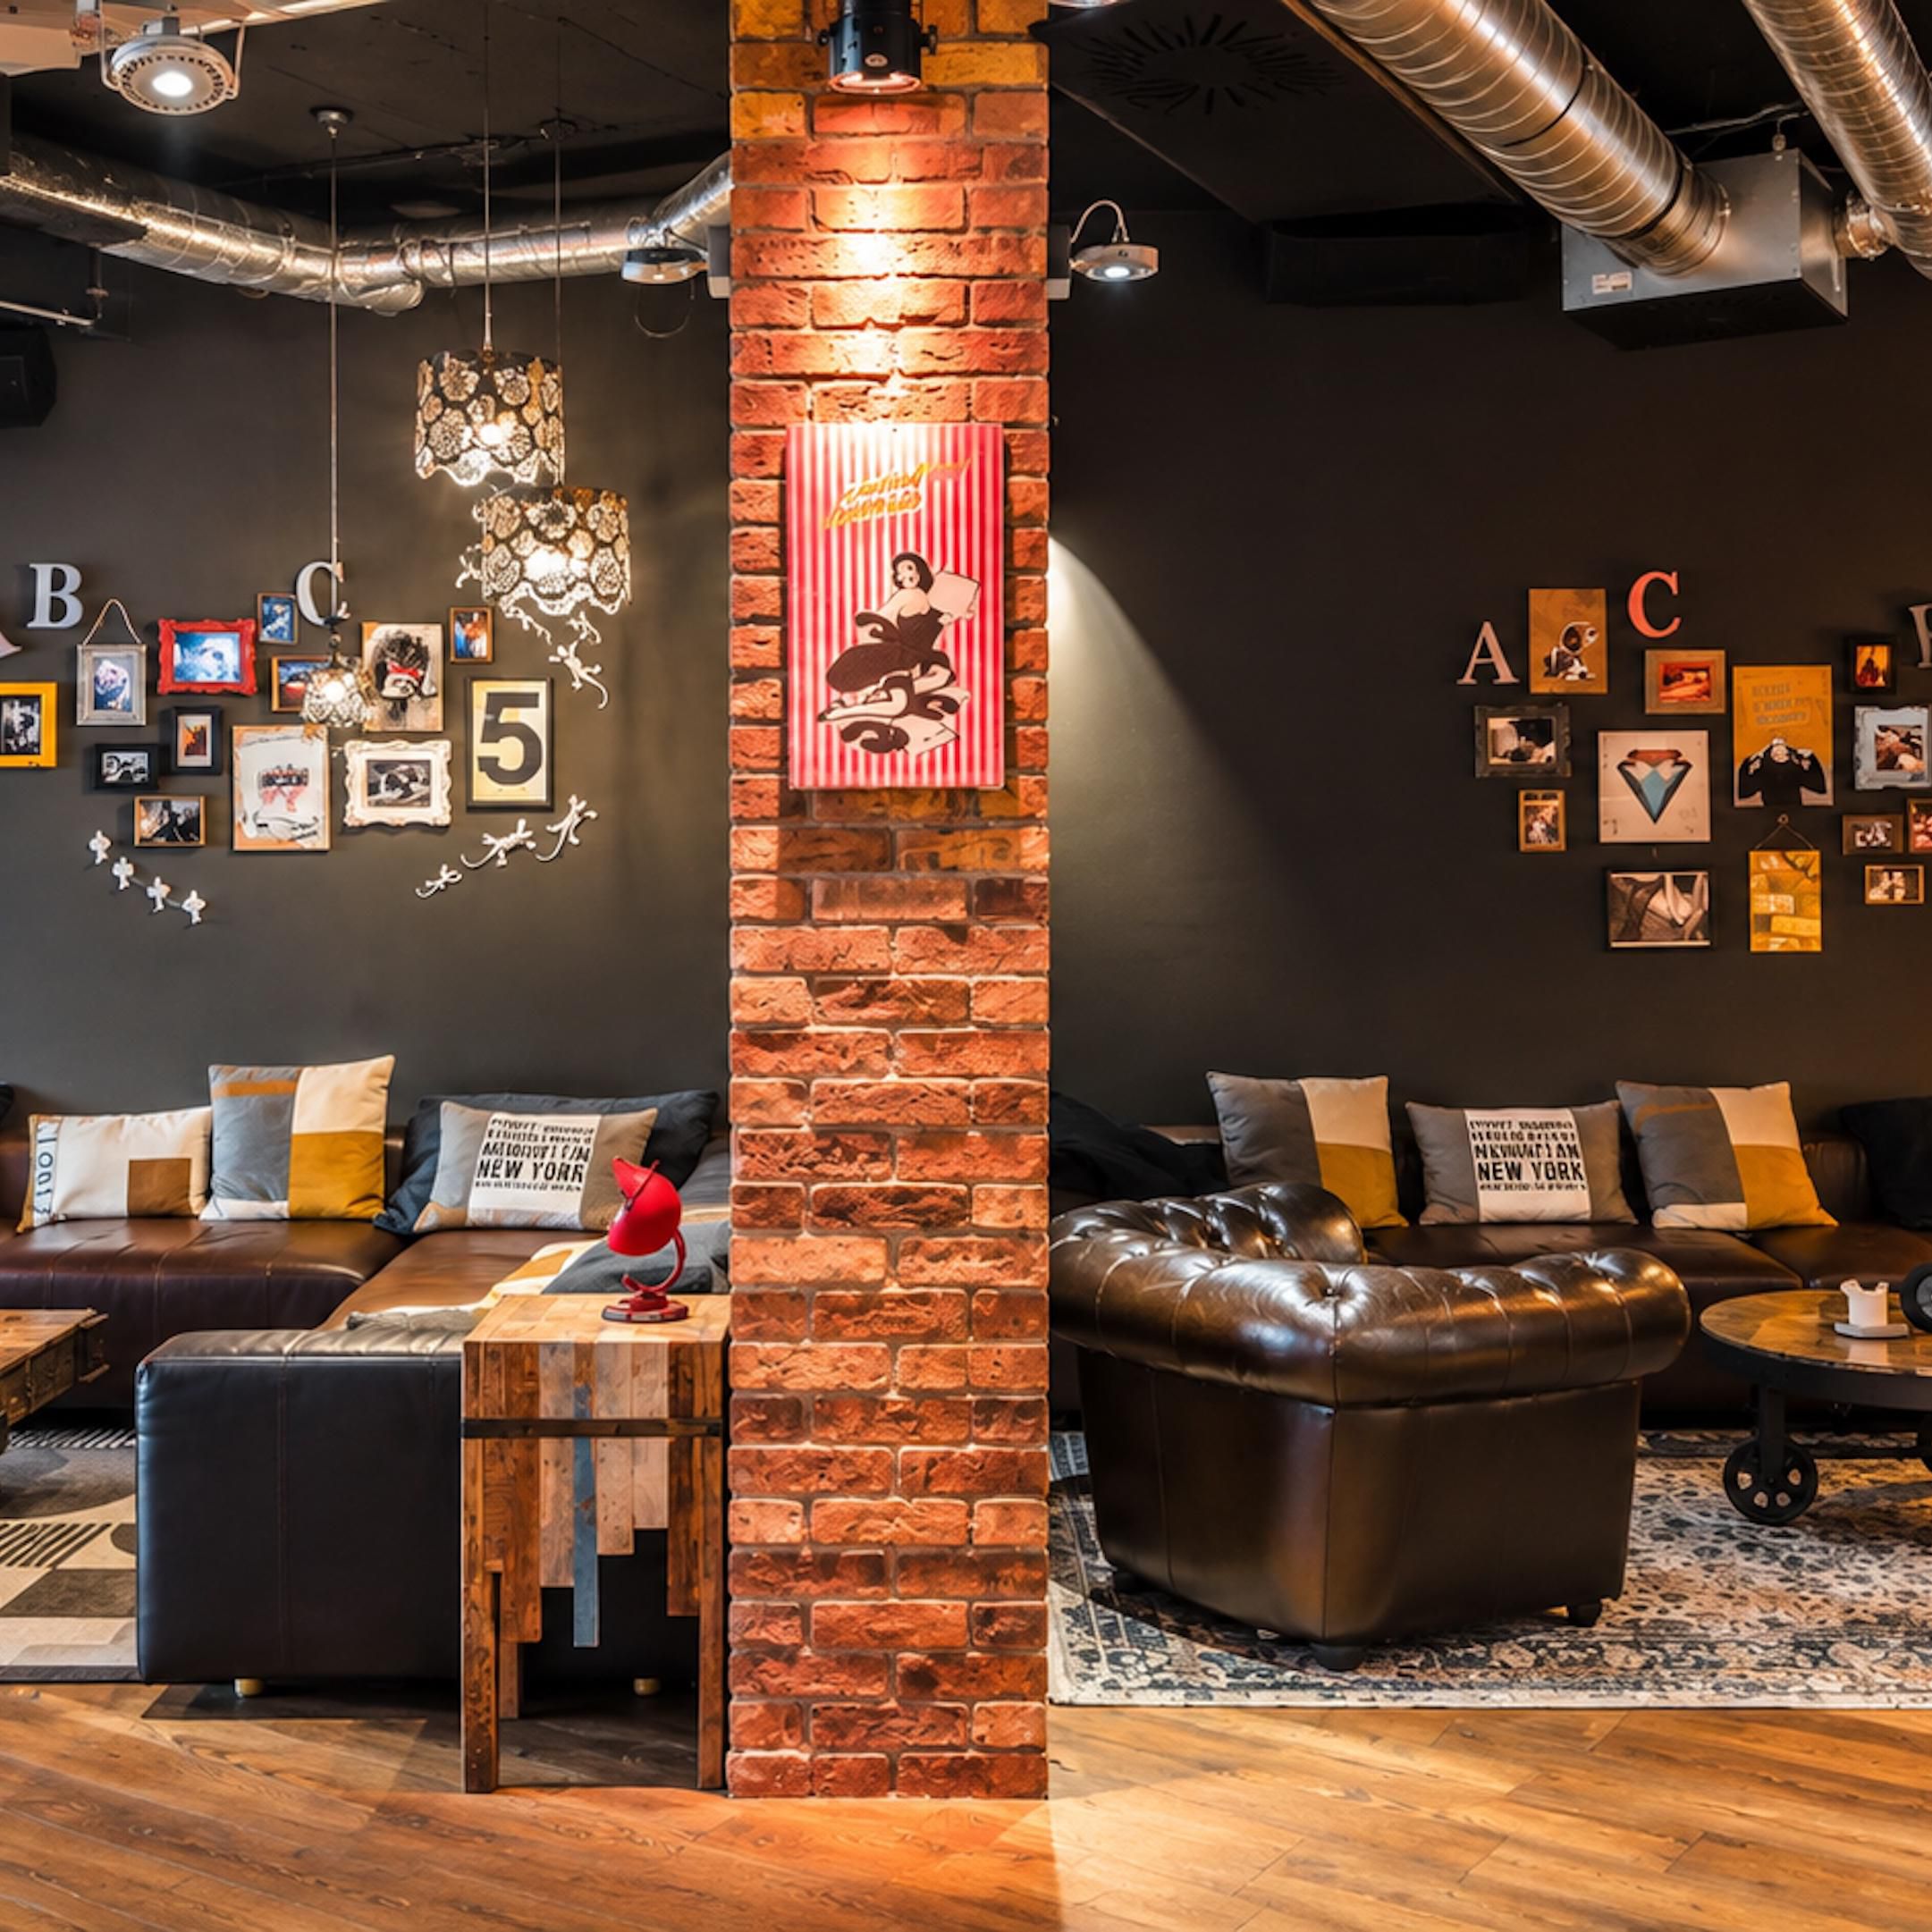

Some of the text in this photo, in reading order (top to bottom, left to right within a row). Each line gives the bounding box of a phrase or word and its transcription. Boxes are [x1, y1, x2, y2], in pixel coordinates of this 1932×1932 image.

[27, 562, 83, 629] B
[296, 561, 351, 627] C
[1628, 571, 1682, 637] C
[1456, 621, 1519, 685] A
[477, 692, 543, 785] 5
[477, 1160, 523, 1179] NEW
[1478, 1162, 1584, 1181] NEW YORK
